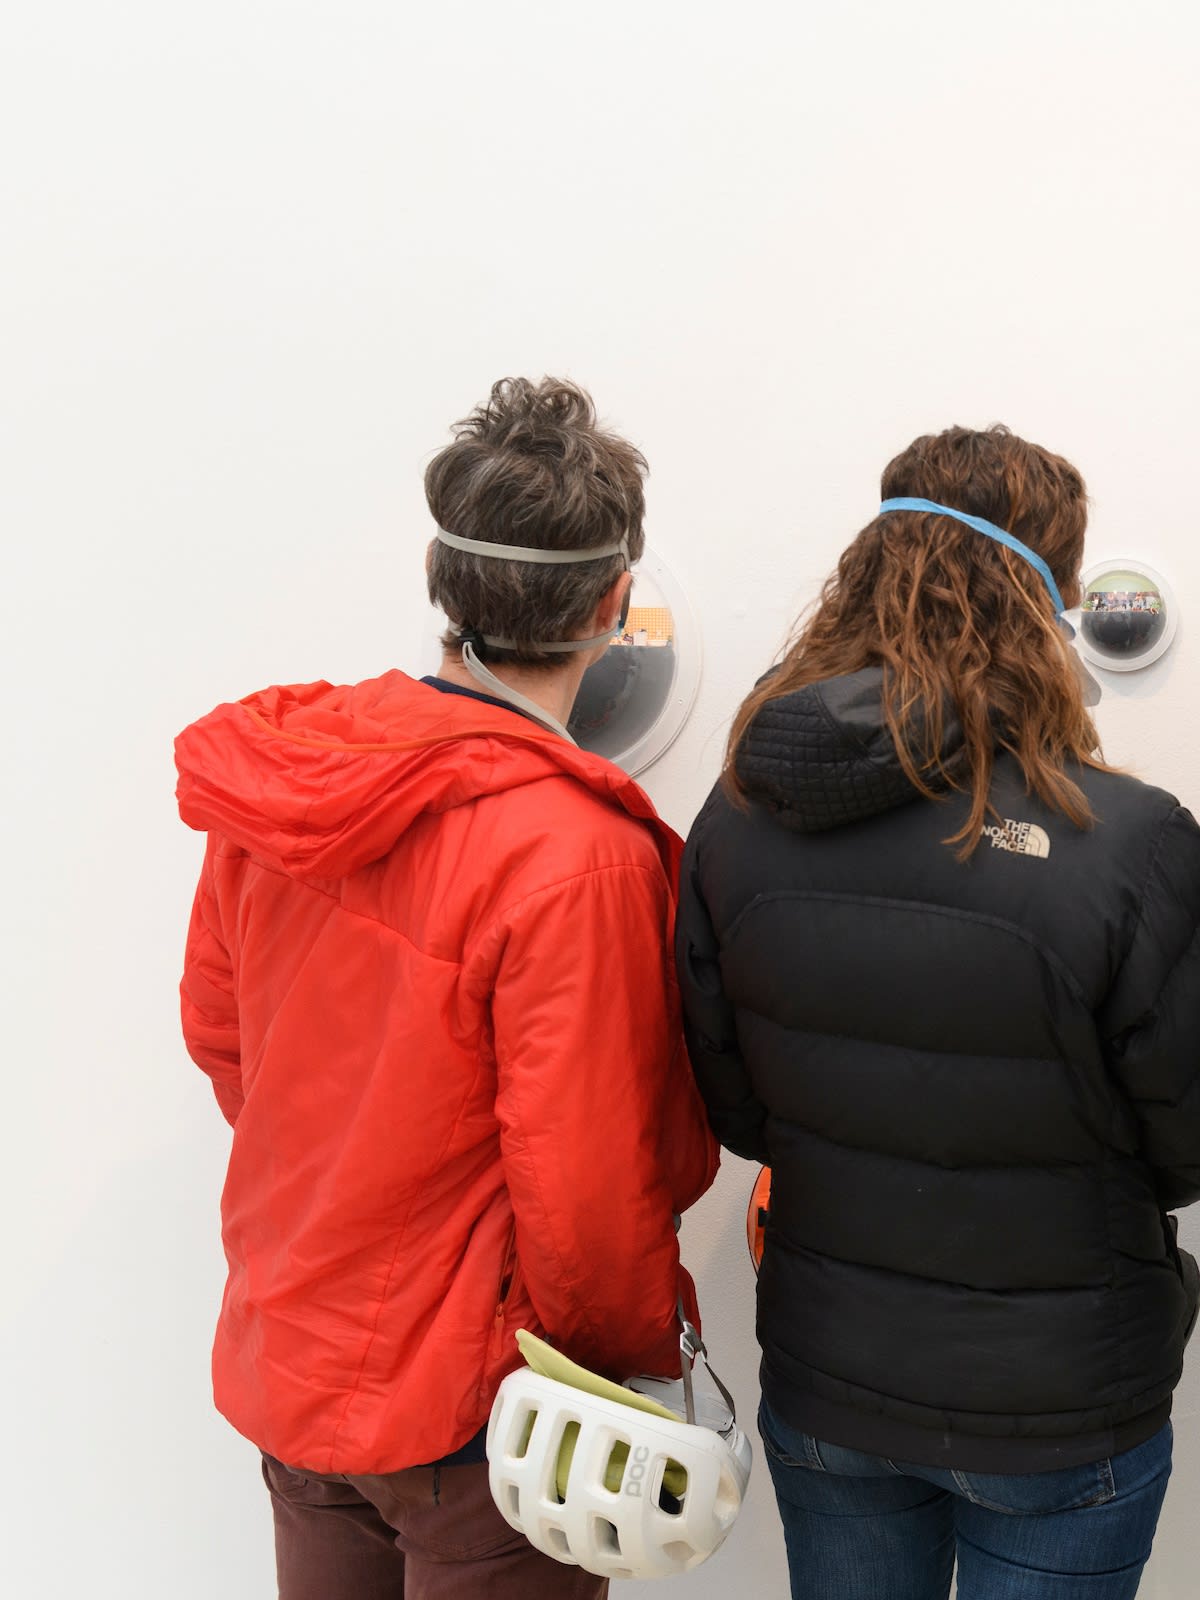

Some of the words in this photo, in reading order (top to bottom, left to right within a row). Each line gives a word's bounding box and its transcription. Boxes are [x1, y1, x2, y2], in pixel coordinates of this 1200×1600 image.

[1004, 818, 1031, 833] THE
[980, 825, 1029, 843] NORTH
[991, 838, 1026, 853] FACE
